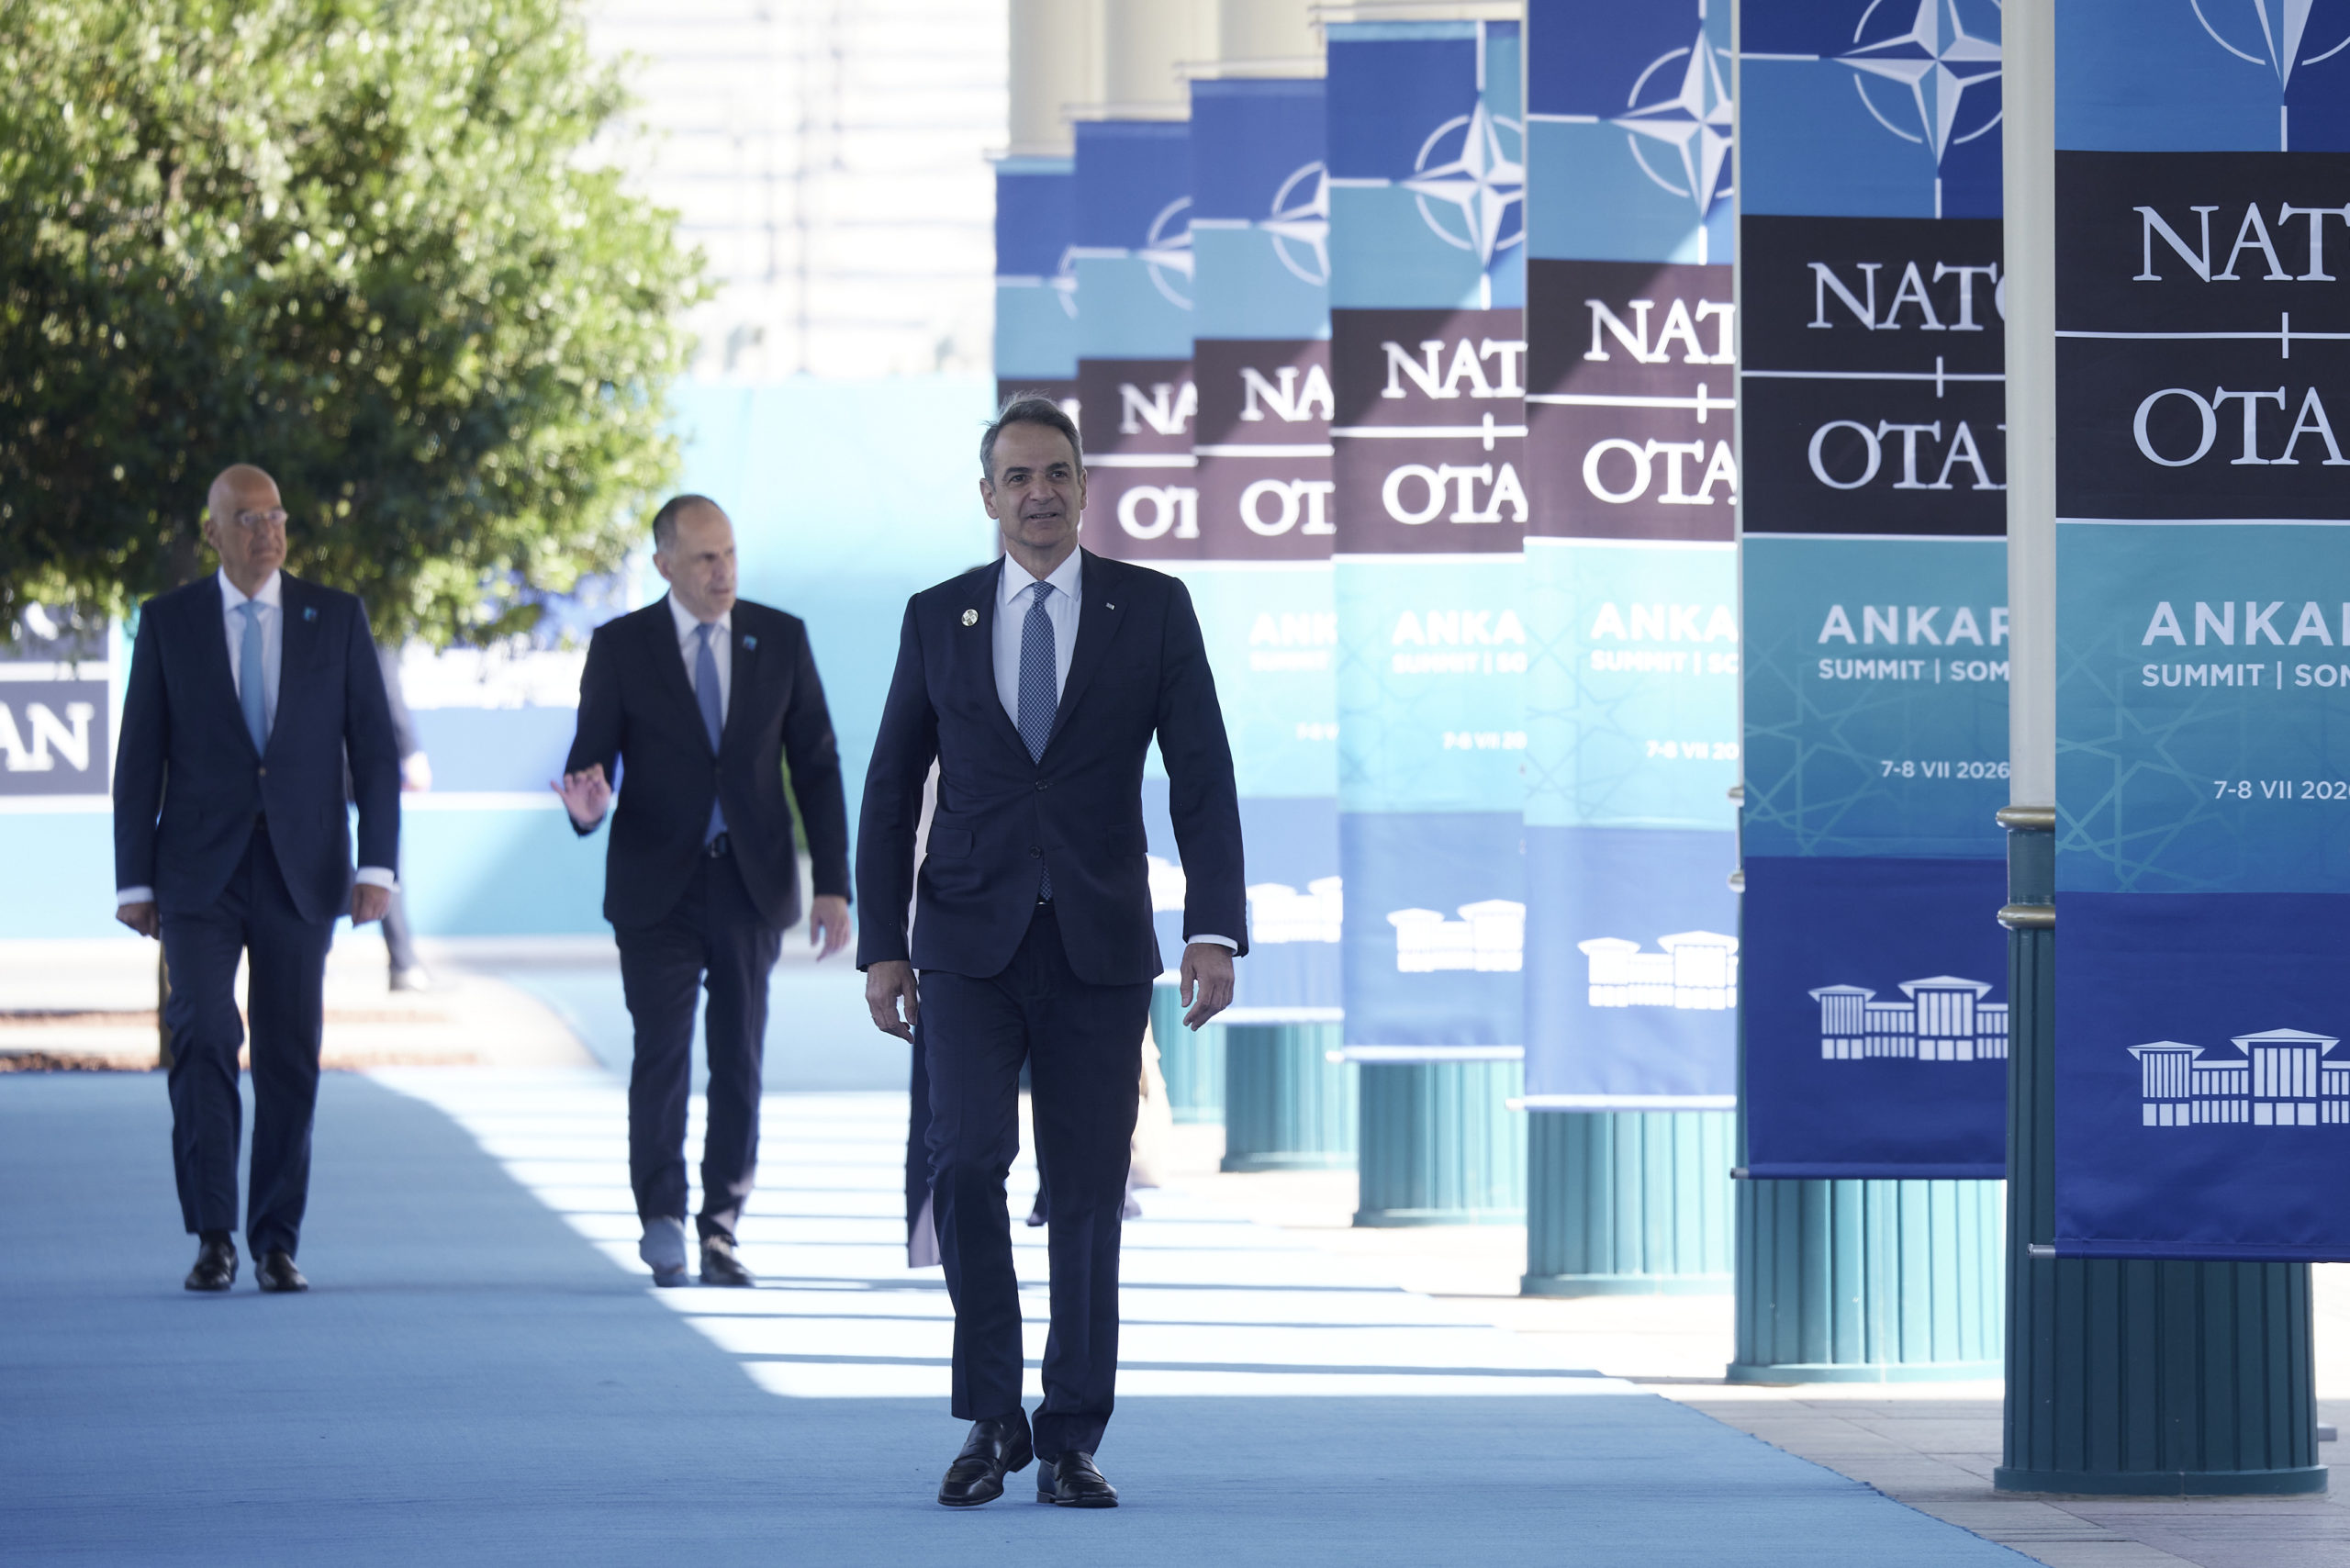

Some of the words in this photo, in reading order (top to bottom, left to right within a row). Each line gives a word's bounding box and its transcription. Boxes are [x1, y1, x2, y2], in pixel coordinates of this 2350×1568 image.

[2132, 202, 2350, 283] NAT
[1807, 261, 2005, 330] NAT
[1381, 337, 1528, 399] NAT
[2132, 386, 2350, 467] OTA
[1807, 419, 2007, 490] OTA
[1382, 462, 1528, 525] OTA
[1392, 610, 1526, 645] ANKA
[1590, 601, 1739, 643] ANKA
[2142, 601, 2350, 646] ANKA
[1590, 649, 1687, 673] SUMMIT
[1818, 658, 1925, 680] SUMMIT
[2142, 663, 2265, 687] SUMMIT
[1646, 739, 1678, 759] 7-8
[1881, 760, 1915, 778] 7-8
[1921, 760, 1950, 778] VII
[1956, 761, 2009, 779] 2026
[2214, 780, 2252, 800] 7-8
[2260, 780, 2292, 800] VII
[2300, 780, 2350, 800] 202
